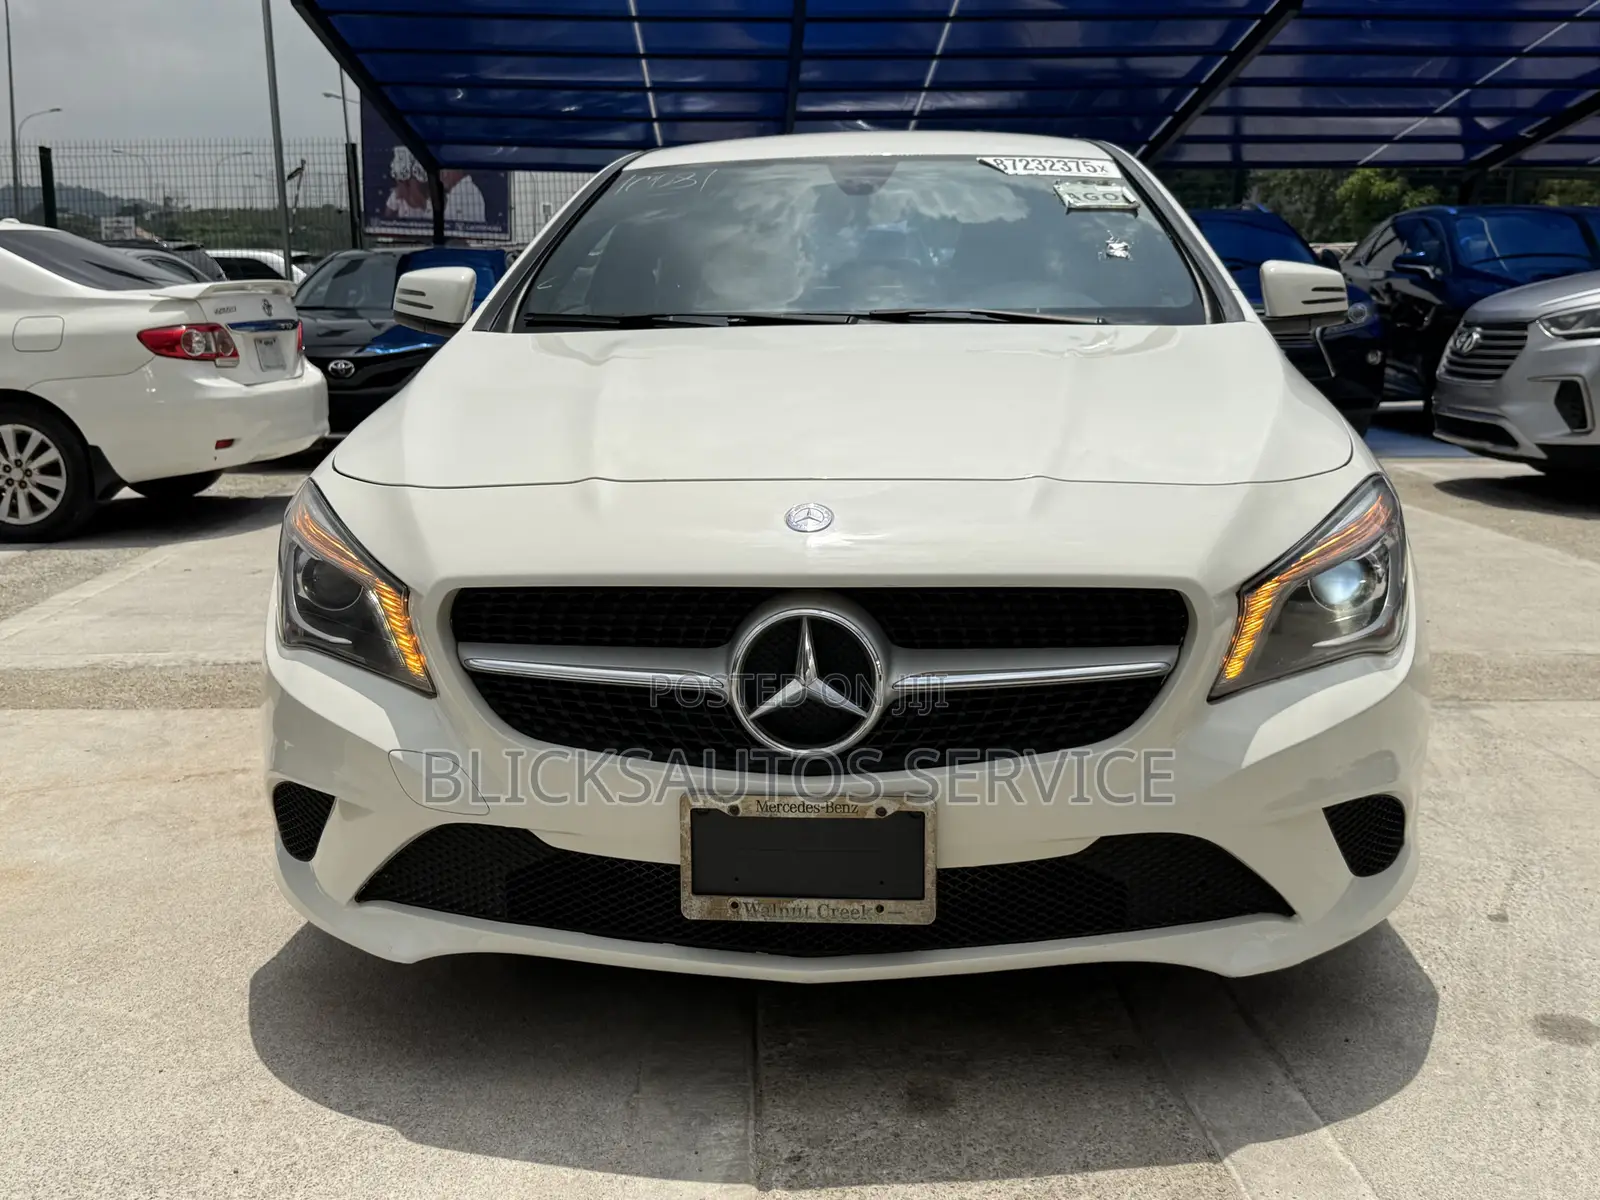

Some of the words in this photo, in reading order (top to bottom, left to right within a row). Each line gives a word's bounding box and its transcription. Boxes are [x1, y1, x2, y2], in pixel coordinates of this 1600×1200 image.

[755, 800, 859, 815] Mercedes-Benz
[743, 902, 815, 920] Walnut
[817, 903, 873, 920] Creek
